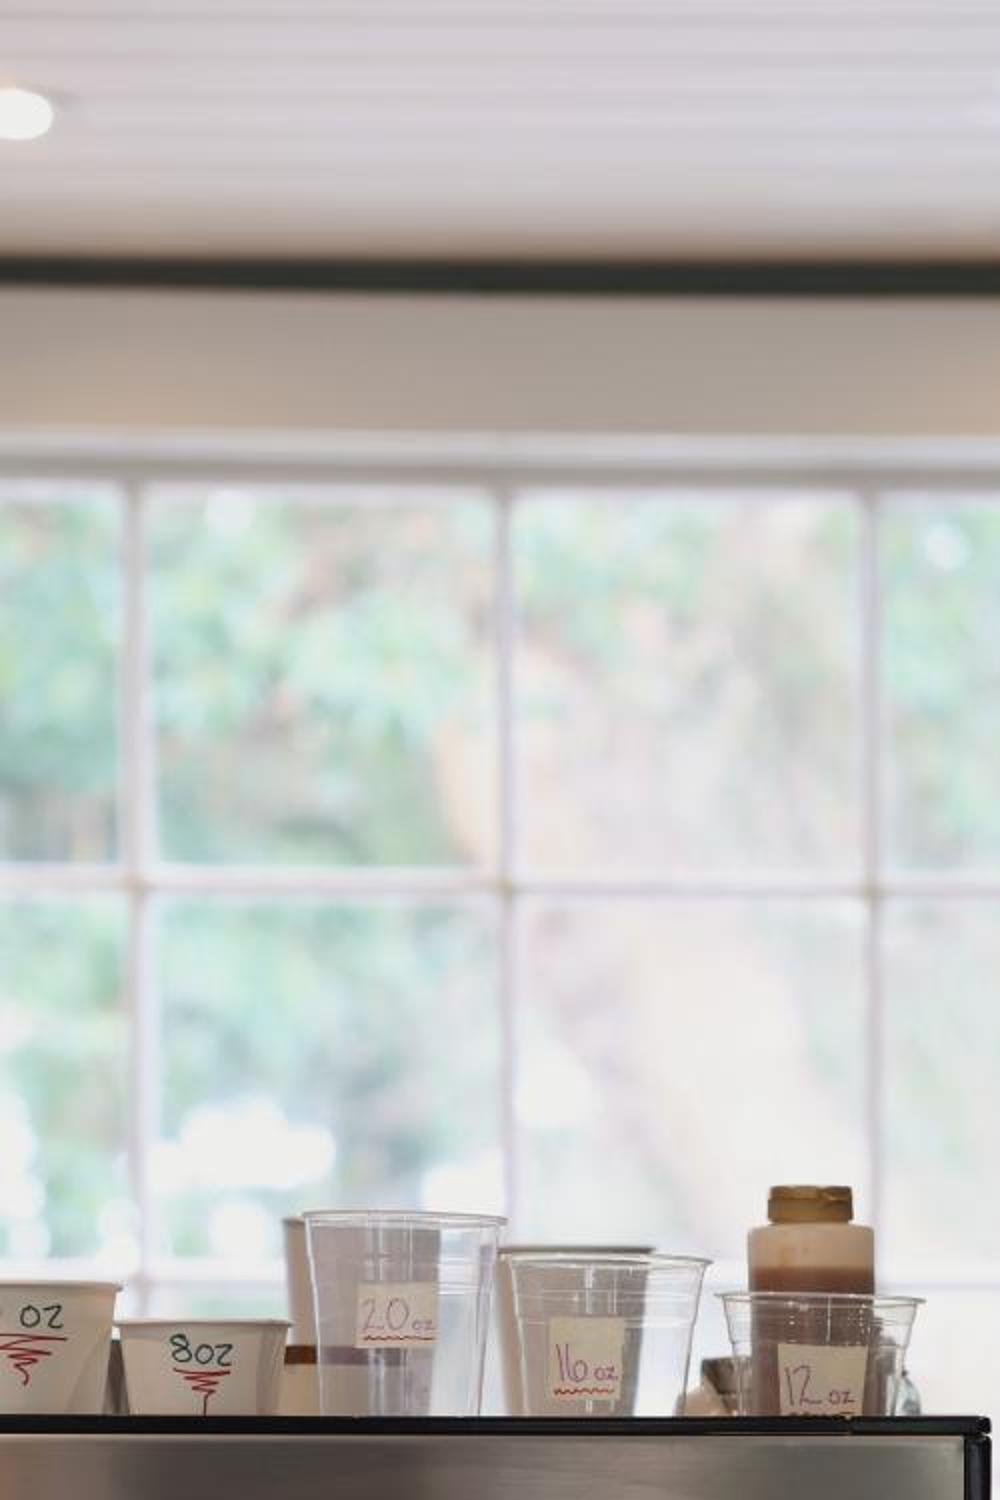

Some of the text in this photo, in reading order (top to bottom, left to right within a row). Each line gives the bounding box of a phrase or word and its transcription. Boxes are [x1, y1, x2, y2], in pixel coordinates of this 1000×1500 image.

[361, 1298, 409, 1331] 20
[555, 1343, 588, 1381] 16
[784, 1365, 821, 1406] 12
